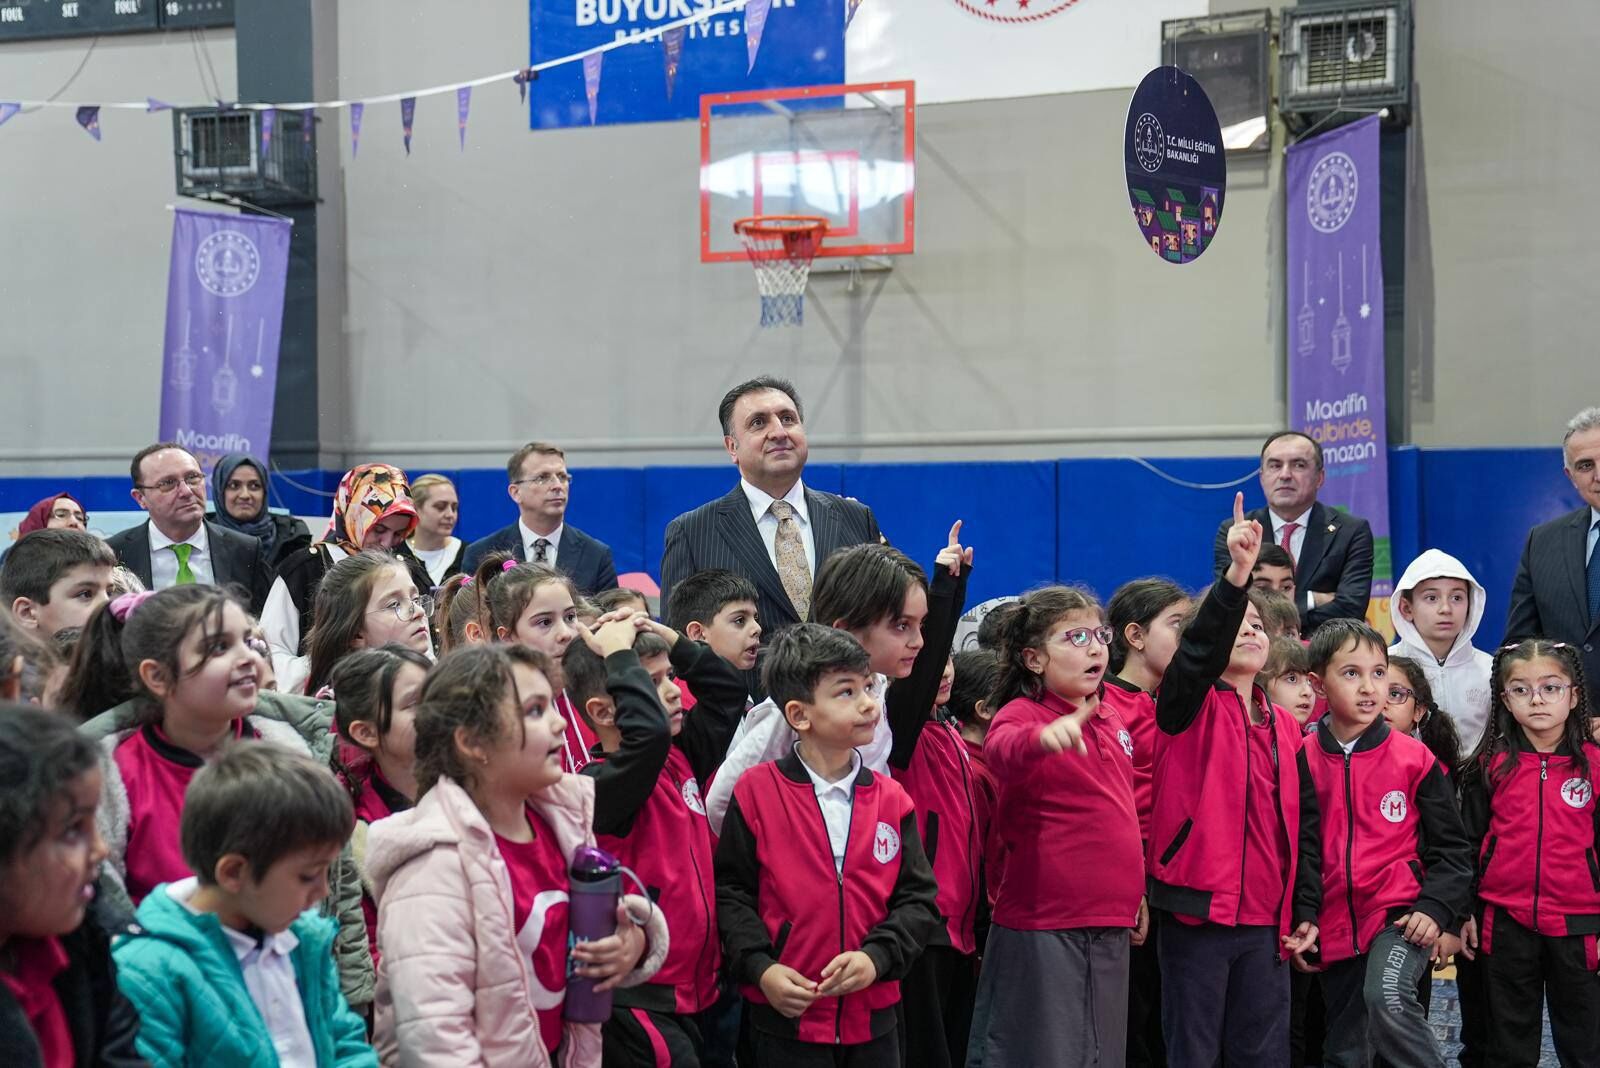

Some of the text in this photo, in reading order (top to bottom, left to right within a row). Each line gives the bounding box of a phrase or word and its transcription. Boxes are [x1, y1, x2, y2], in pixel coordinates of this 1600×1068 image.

[1166, 149, 1199, 164] BAKANLIĞI
[1194, 140, 1216, 154] EĞİTİM
[1306, 391, 1367, 422] Maarifin
[176, 428, 251, 452] Maarifin
[1322, 441, 1377, 464] mazan
[1390, 801, 1402, 817] M
[877, 836, 888, 855] M
[1382, 944, 1408, 1014] KEEP MOVING
